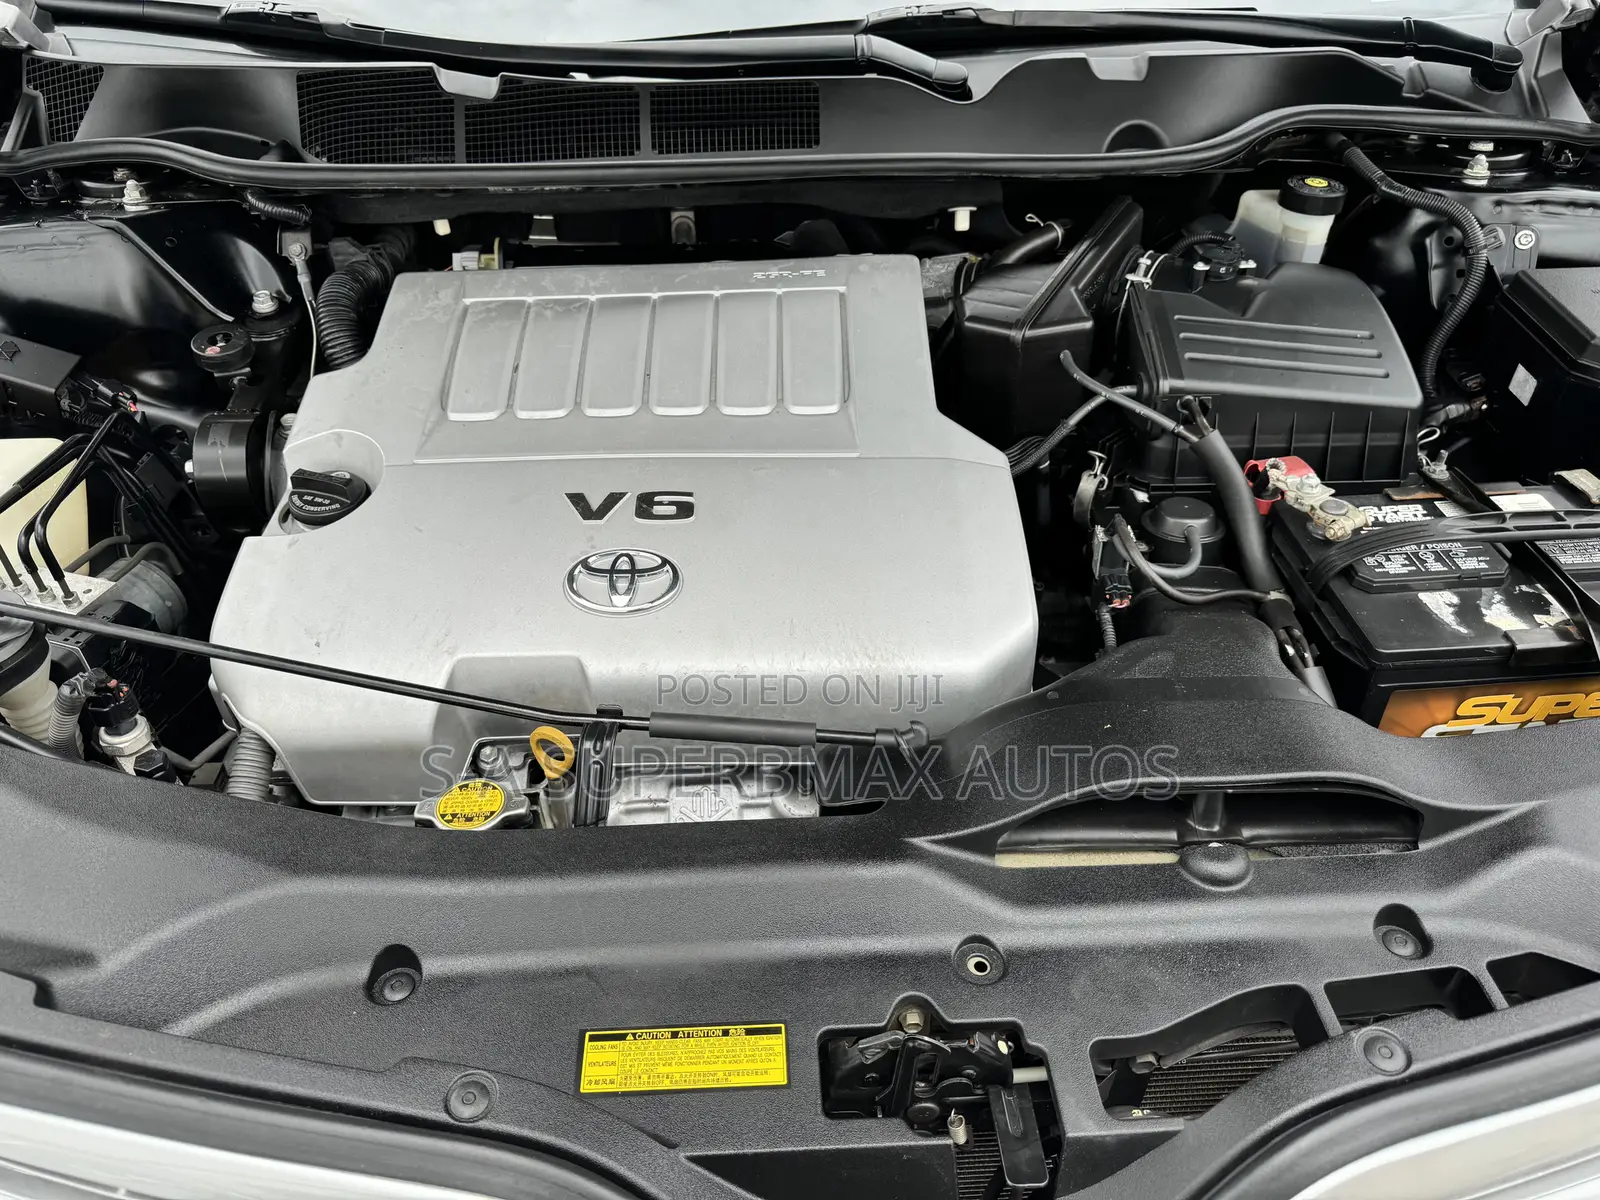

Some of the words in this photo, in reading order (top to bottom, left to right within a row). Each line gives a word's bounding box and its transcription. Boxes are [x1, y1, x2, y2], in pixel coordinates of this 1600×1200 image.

[302, 503, 341, 512] CONSERVING
[563, 491, 696, 524] V6
[1358, 504, 1428, 514] SUPER
[1426, 542, 1463, 550] POISON
[635, 1031, 671, 1039] CAUTION
[677, 1029, 722, 1037] ATTENTION
[585, 1078, 615, 1086] 冷却风扇
